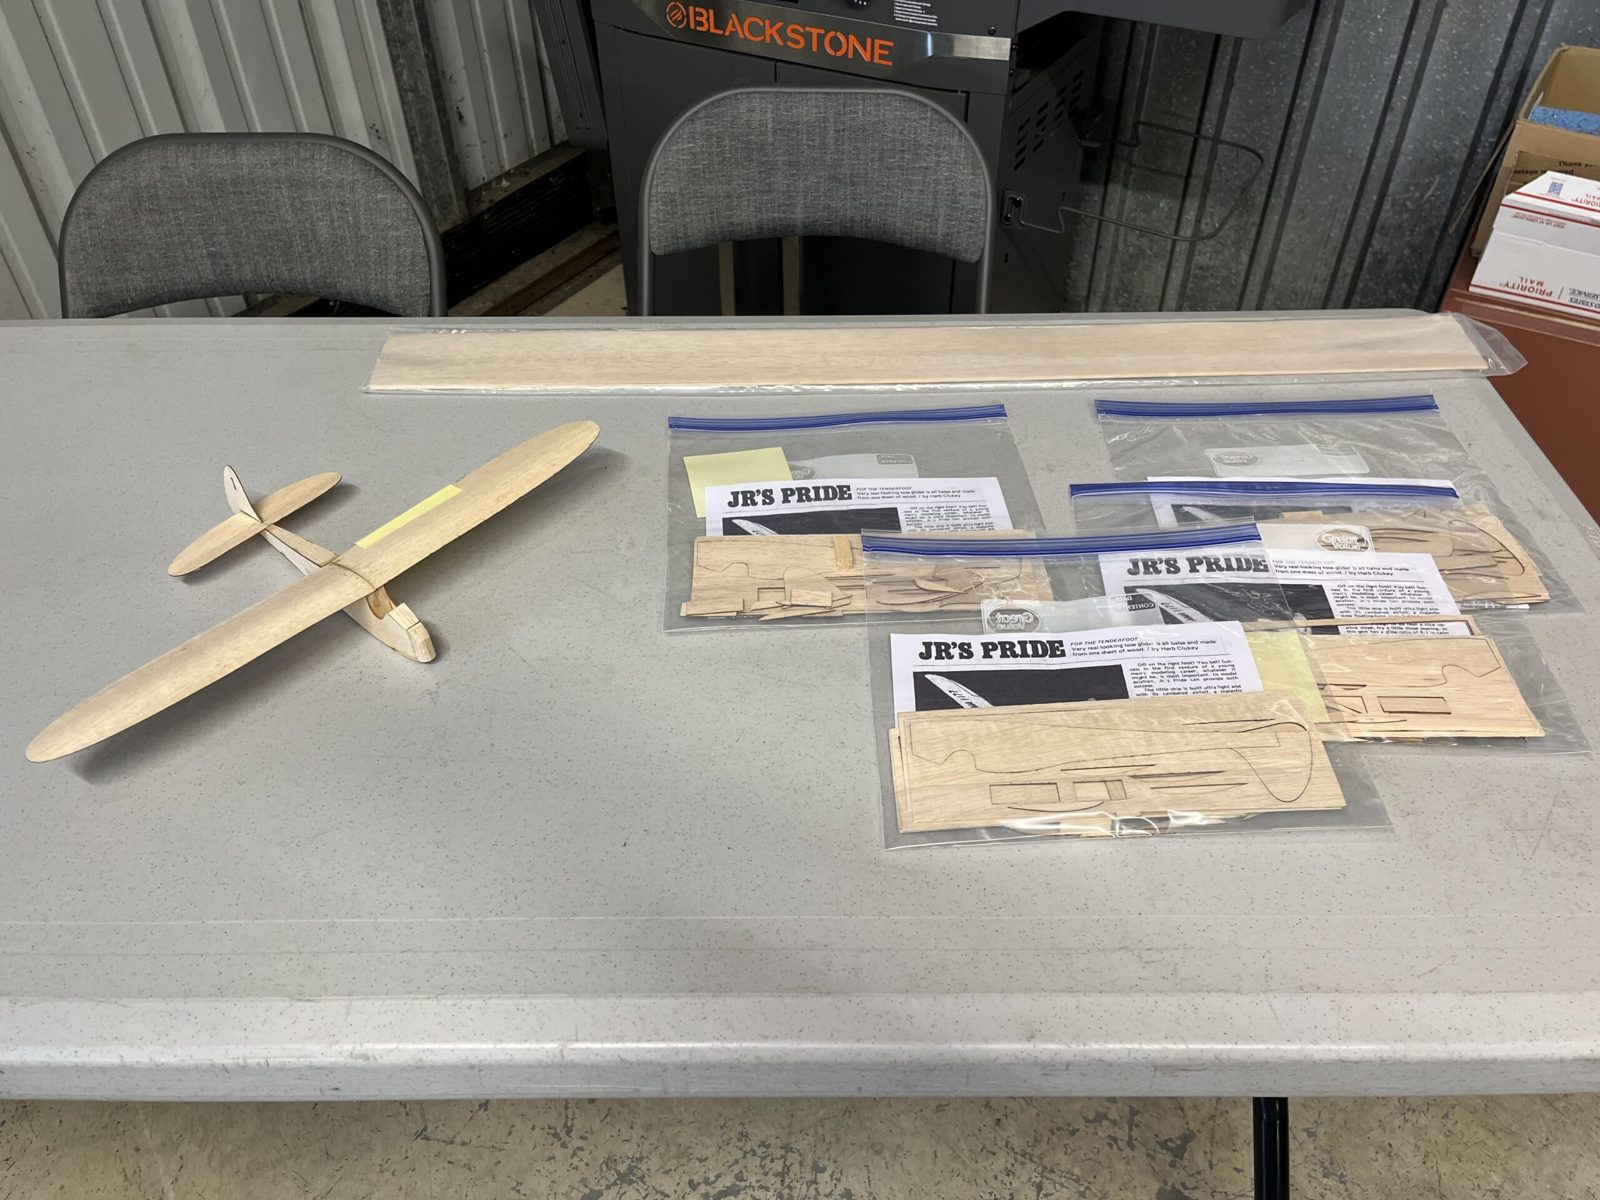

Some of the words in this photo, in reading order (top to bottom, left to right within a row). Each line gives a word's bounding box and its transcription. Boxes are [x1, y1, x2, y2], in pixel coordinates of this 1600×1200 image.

[689, 5, 895, 66] BLACKSTONE
[1574, 197, 1600, 209] RIORITY
[1519, 276, 1544, 287] MAIL
[727, 489, 775, 508] JR'S
[781, 484, 853, 504] PRIDE
[1127, 557, 1181, 576] JR'S
[1185, 555, 1269, 573] PRIDE
[919, 641, 975, 660] JR'S
[980, 639, 1066, 659] PRIDE
[1098, 636, 1138, 644] TENDERFOOT
